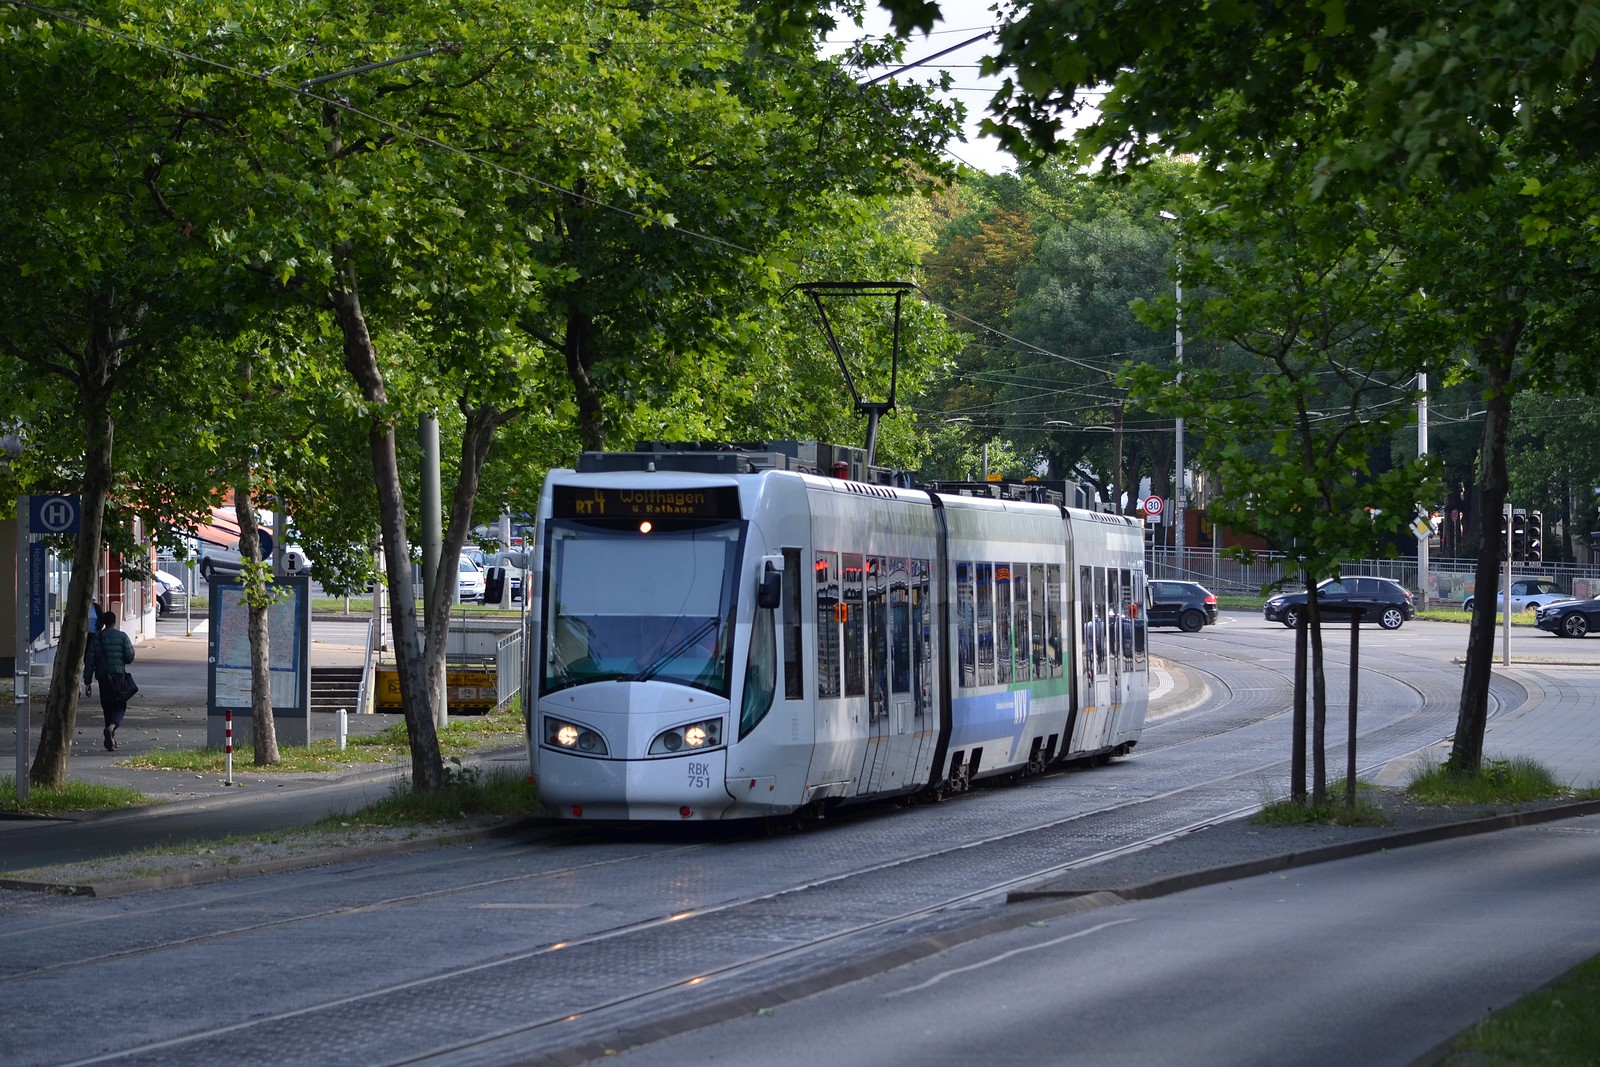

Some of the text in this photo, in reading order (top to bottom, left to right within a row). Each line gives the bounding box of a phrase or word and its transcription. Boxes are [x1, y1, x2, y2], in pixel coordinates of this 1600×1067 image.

[575, 489, 606, 514] RT4
[620, 489, 704, 505] Wolfhagen
[646, 504, 694, 513] Rathaus
[1148, 501, 1159, 511] 30
[33, 597, 41, 616] Platz
[688, 762, 710, 776] RBK
[688, 775, 710, 789] 751
